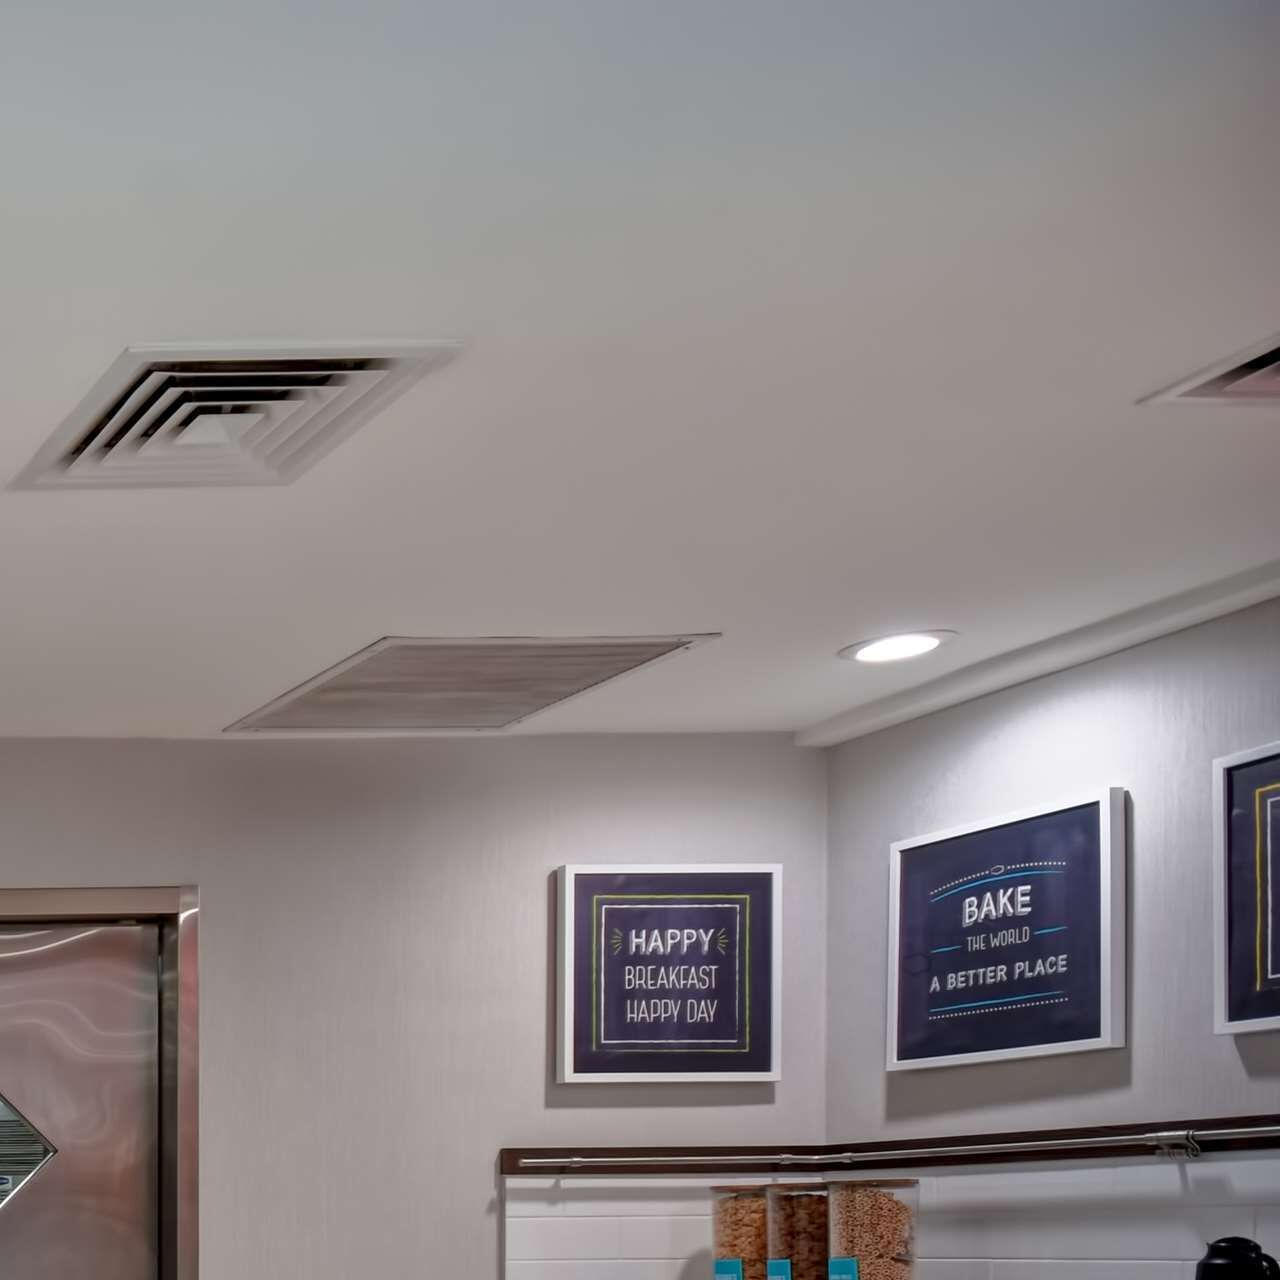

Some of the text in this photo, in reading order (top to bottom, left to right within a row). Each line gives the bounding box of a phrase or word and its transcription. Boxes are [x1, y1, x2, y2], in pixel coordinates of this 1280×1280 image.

[962, 885, 1032, 928] BAKE
[629, 929, 715, 955] HAPPY
[966, 926, 1030, 952] THE WORLD
[625, 965, 719, 989] BREAKFAST
[929, 954, 1068, 993] A BETTER PLACE
[627, 999, 717, 1023] HAPPY DAY
